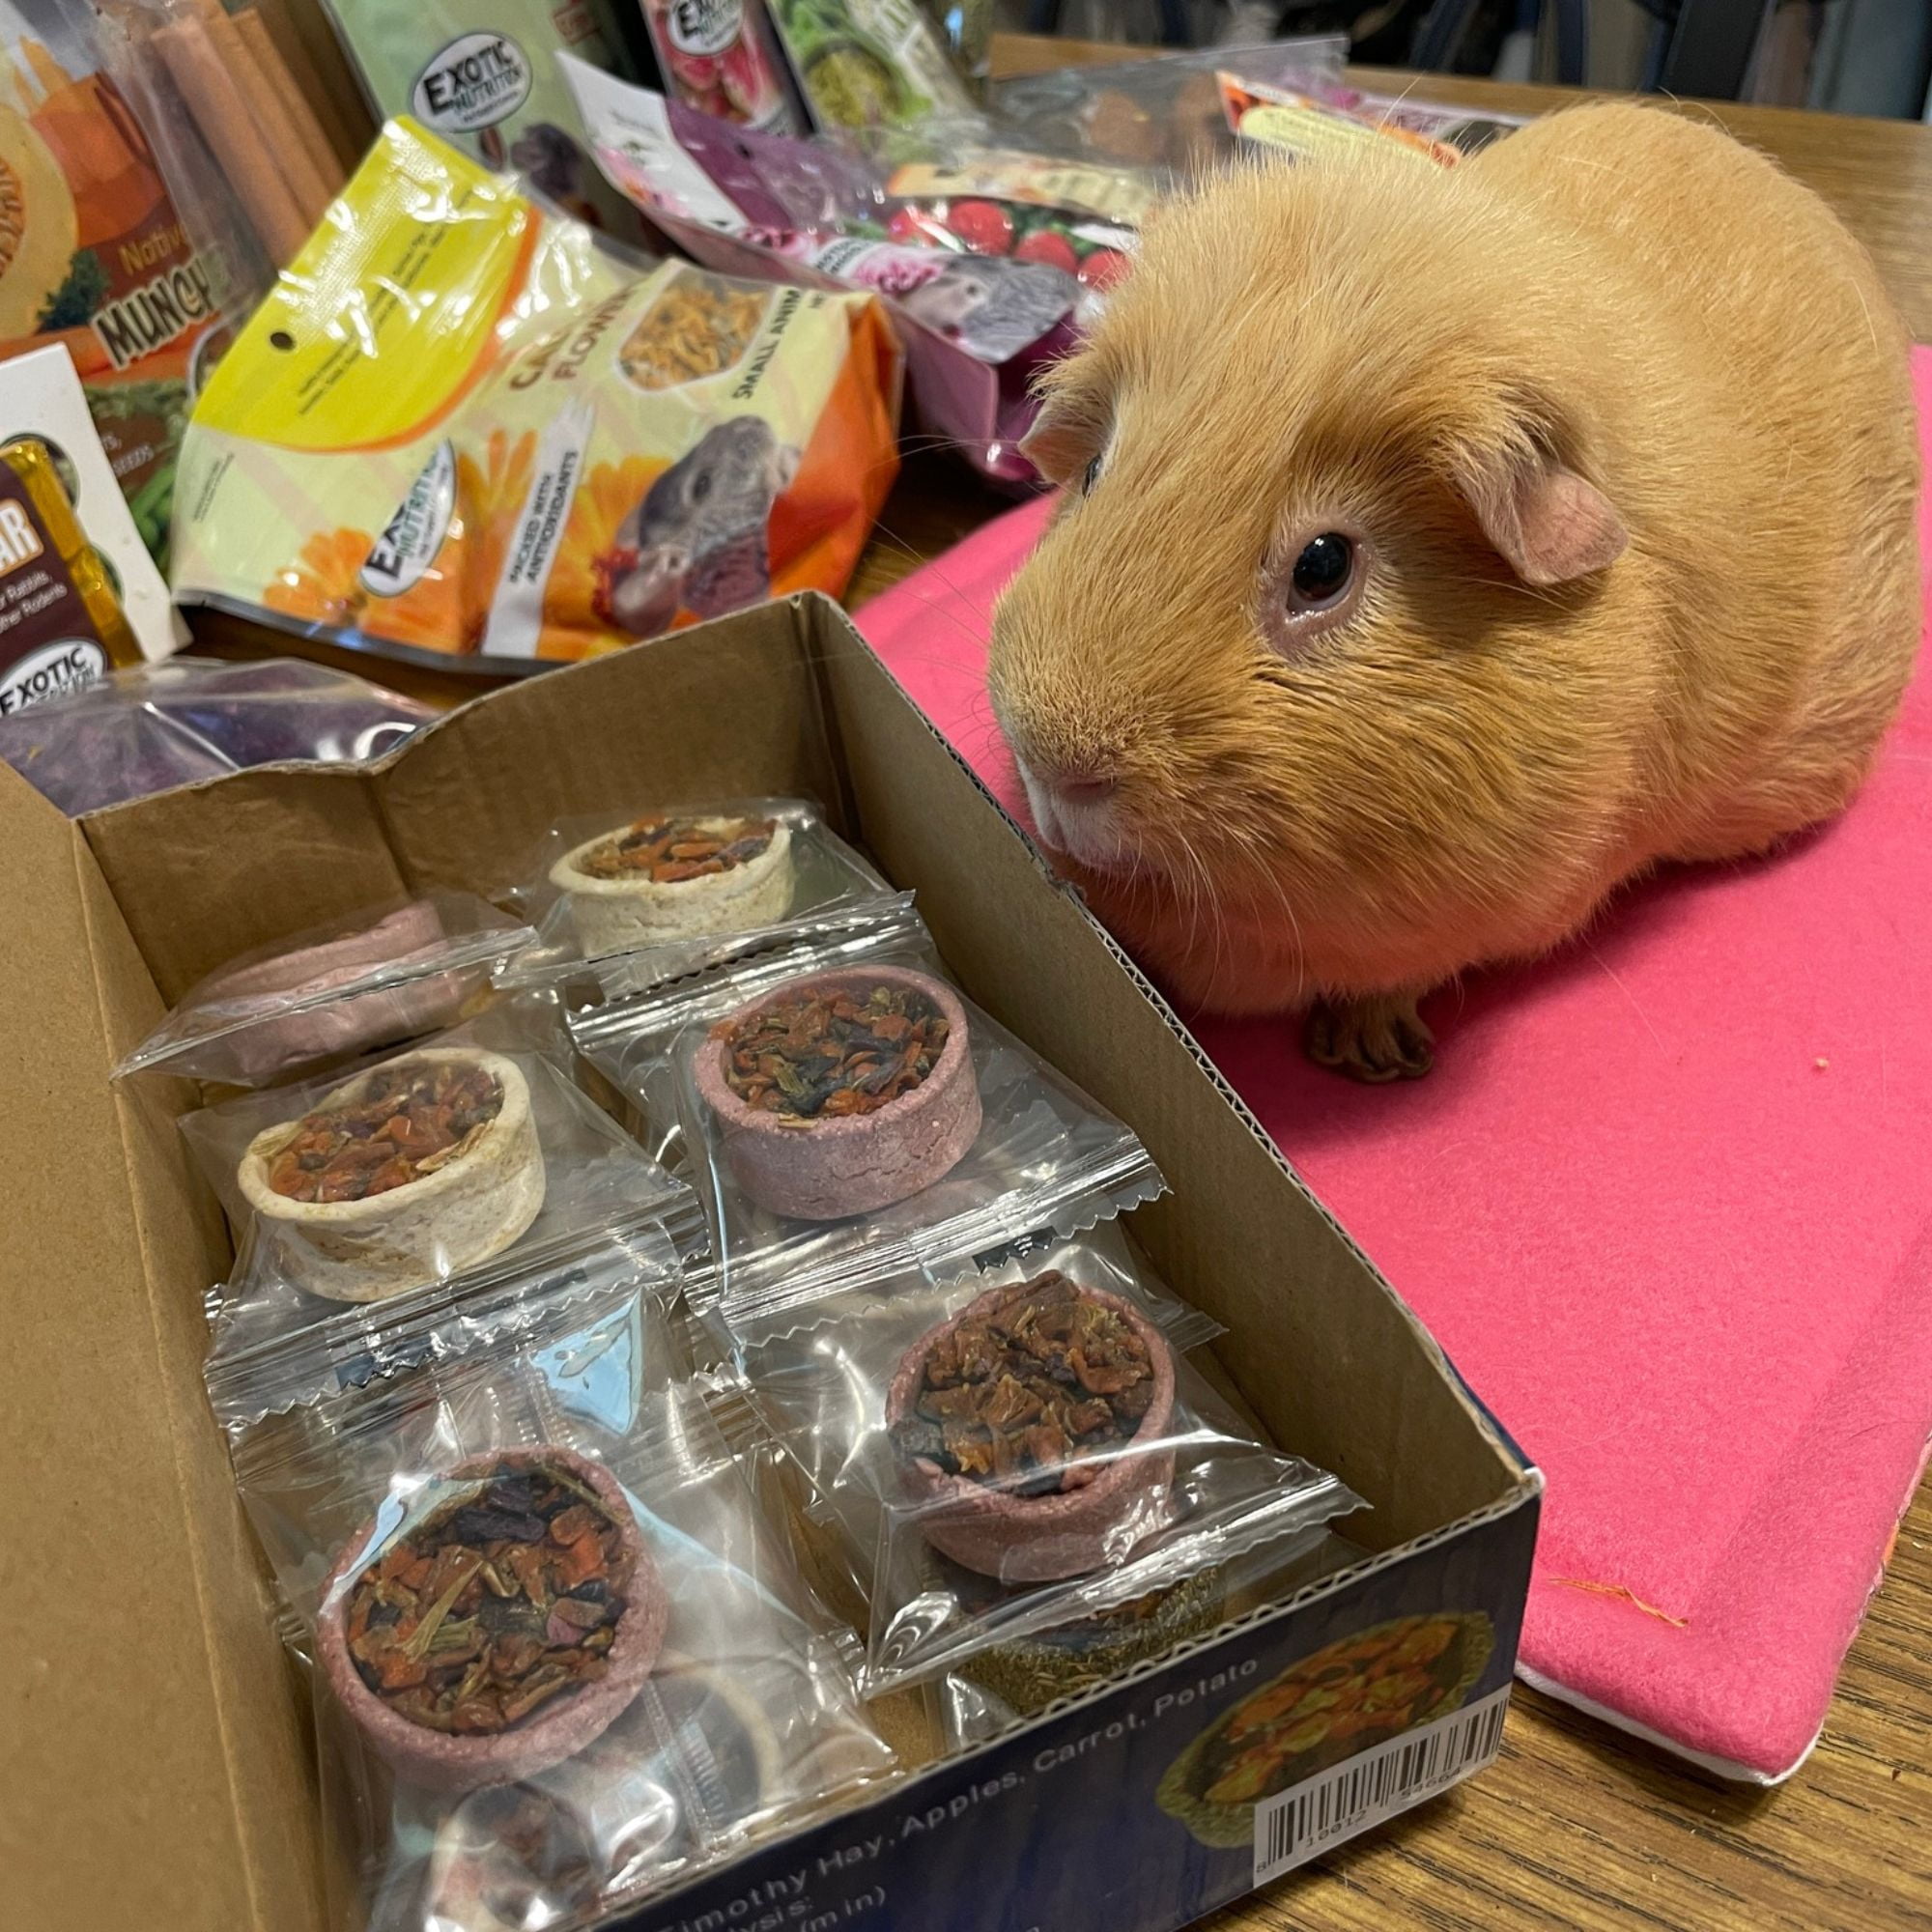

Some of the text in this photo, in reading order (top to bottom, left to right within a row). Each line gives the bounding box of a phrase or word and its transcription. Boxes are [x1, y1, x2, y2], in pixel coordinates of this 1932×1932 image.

[423, 41, 513, 115] EXOTIC
[732, 340, 780, 399] SMALL
[1034, 1712, 1148, 1773] Carrot,
[1153, 1657, 1258, 1717] Potato
[1305, 1809, 1368, 1849] 10012
